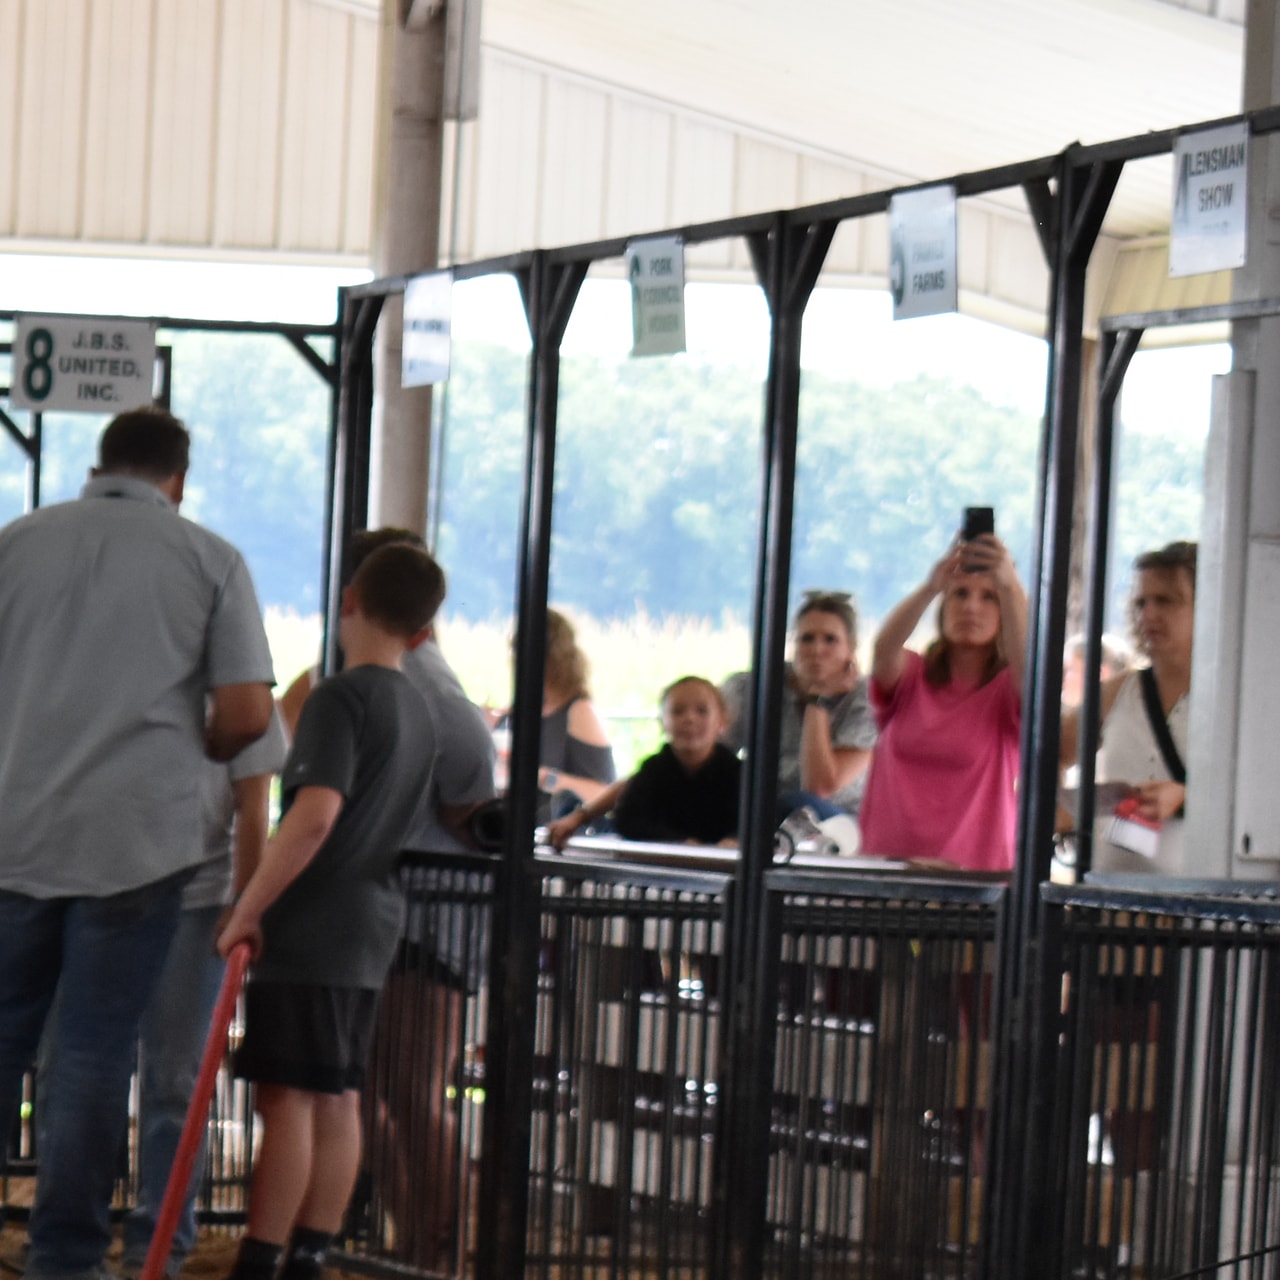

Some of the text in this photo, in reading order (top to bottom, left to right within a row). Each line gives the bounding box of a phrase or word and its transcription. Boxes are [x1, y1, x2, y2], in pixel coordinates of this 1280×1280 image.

[1188, 143, 1244, 176] LENSMAN
[1198, 184, 1233, 212] SHOW
[912, 270, 945, 294] FARMS
[71, 331, 130, 350] J.B.S.
[23, 328, 54, 402] 8
[58, 356, 143, 378] UNITED,
[77, 383, 120, 402] INC.
